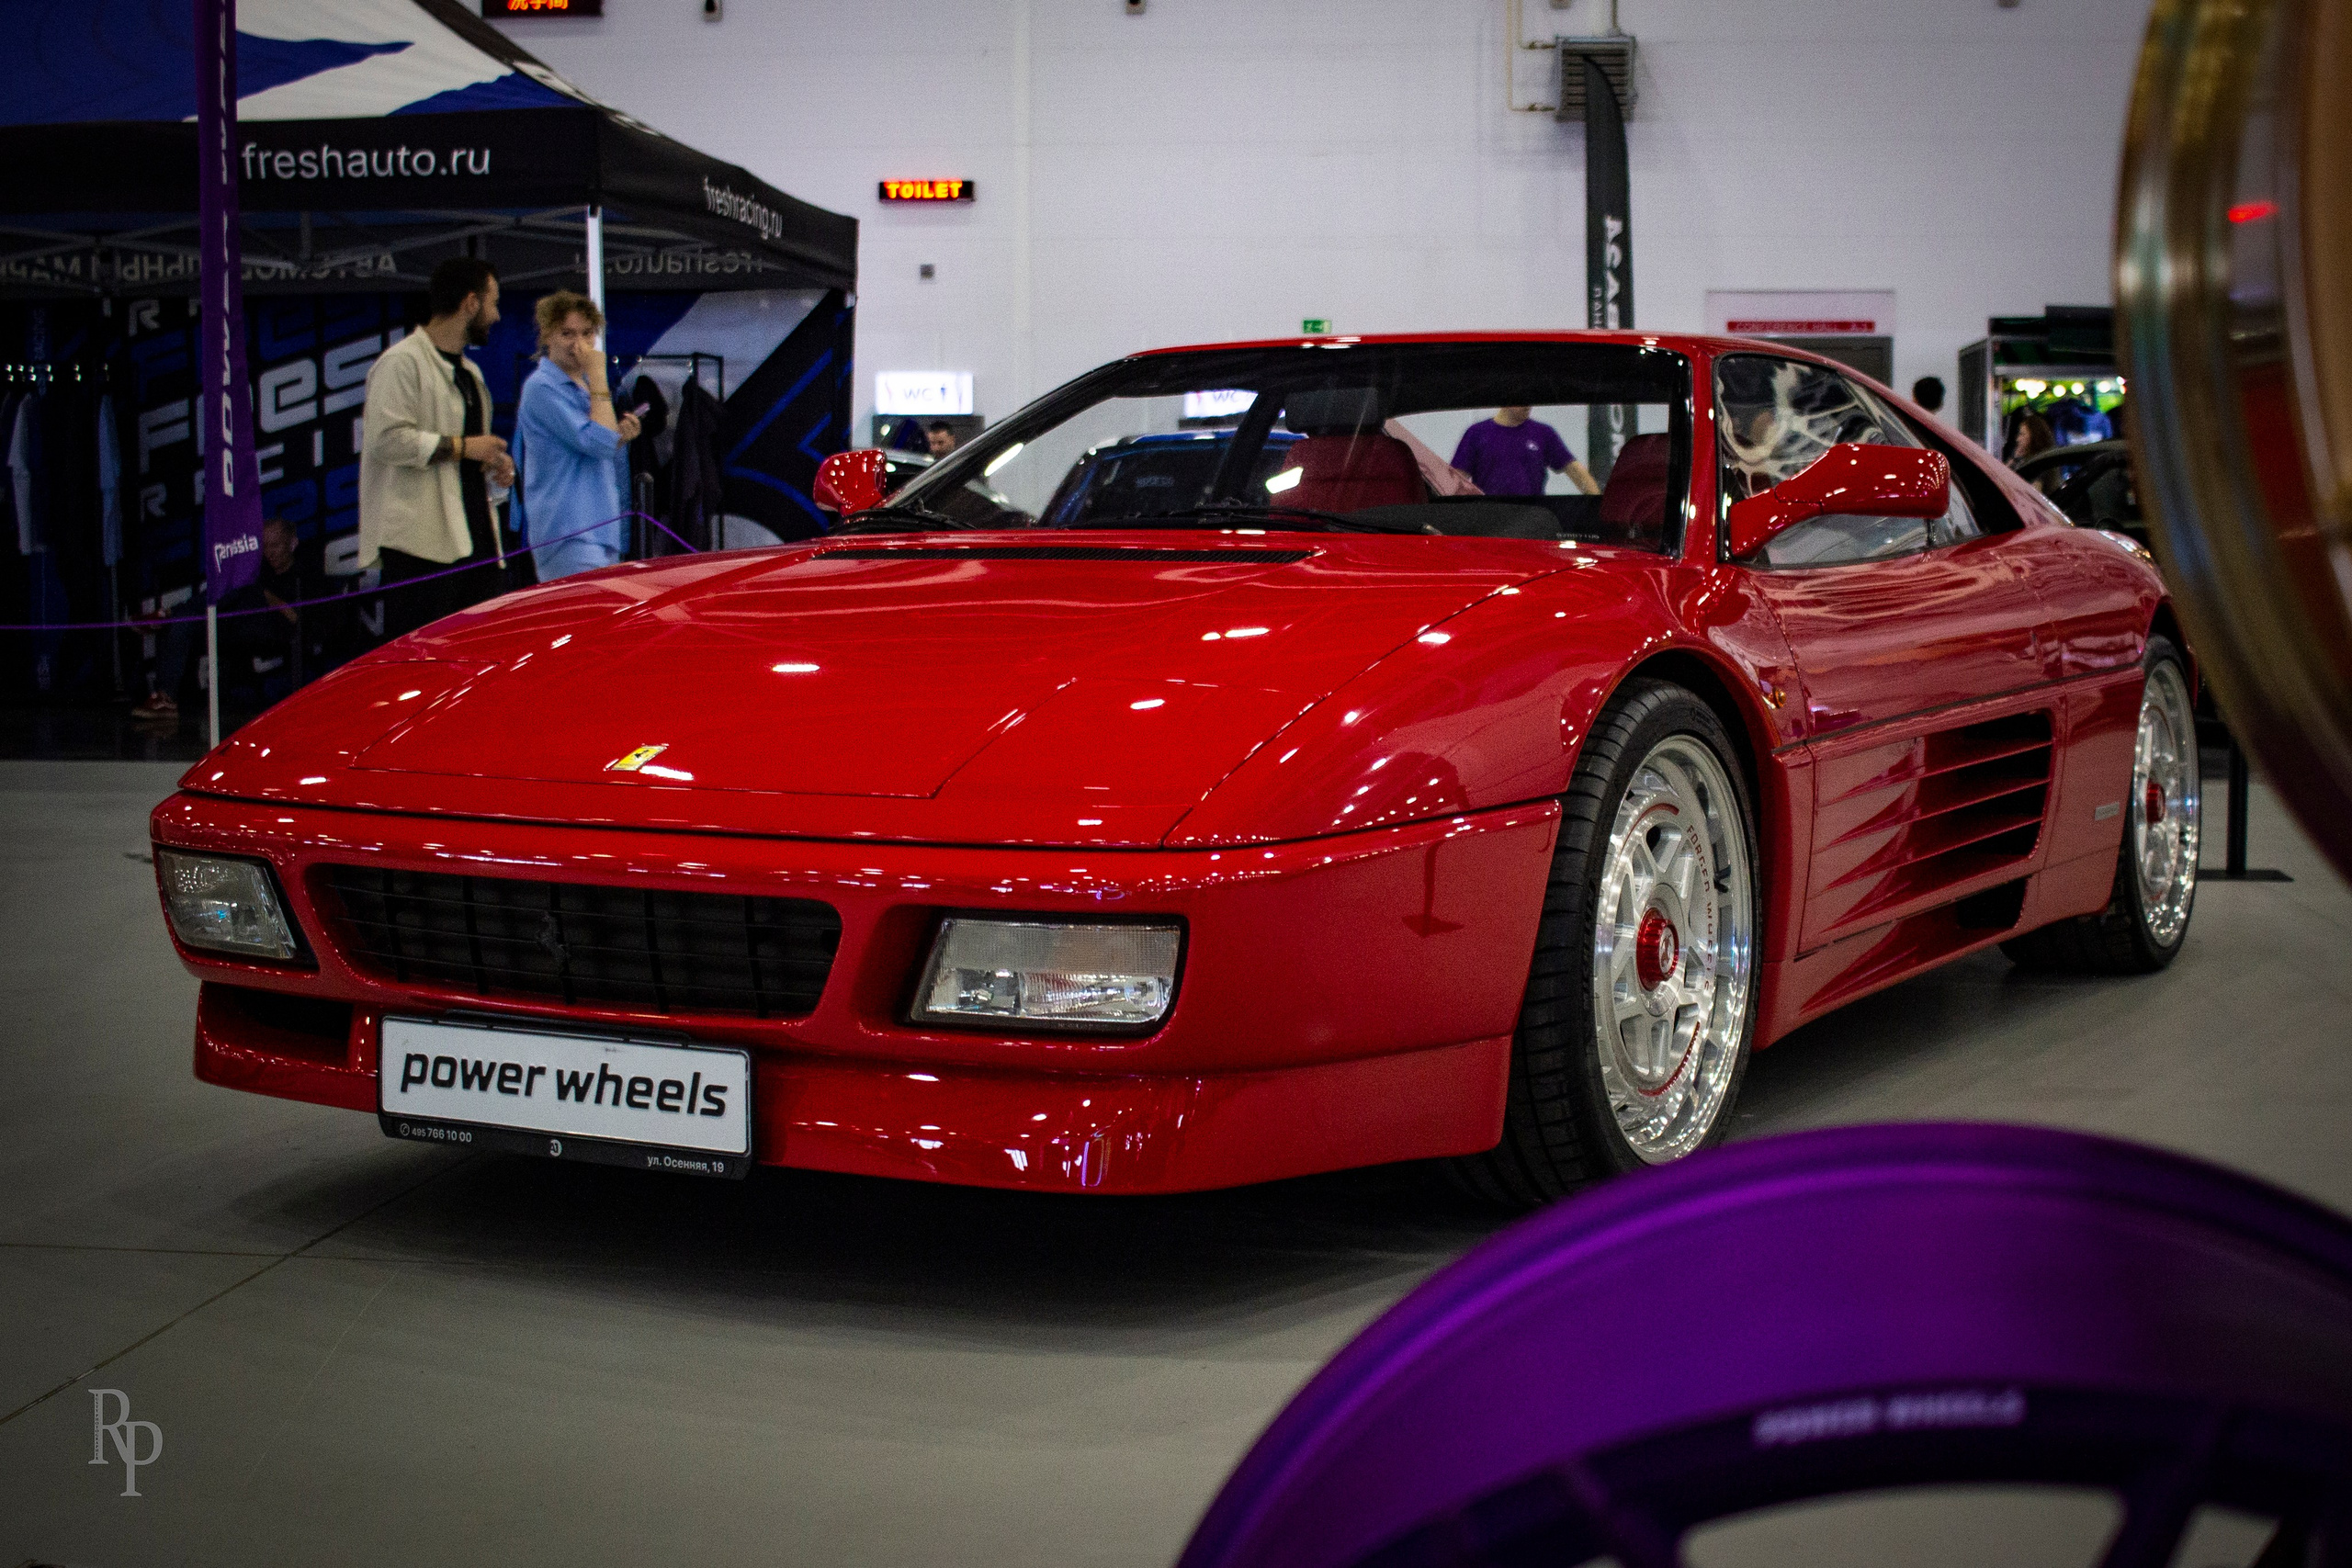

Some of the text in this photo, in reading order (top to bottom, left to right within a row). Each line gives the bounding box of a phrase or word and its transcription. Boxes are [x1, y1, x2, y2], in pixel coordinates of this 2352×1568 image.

[243, 142, 491, 180] freshauto.ru
[884, 180, 962, 198] TOILET
[703, 175, 783, 240] freshracing.ru
[903, 388, 933, 401] WC
[1687, 825, 1710, 892] FORGED
[400, 1053, 728, 1117] power wheels
[412, 1127, 472, 1143] 495 766 10 00
[647, 1156, 725, 1173] ул. Осенняя, 19
